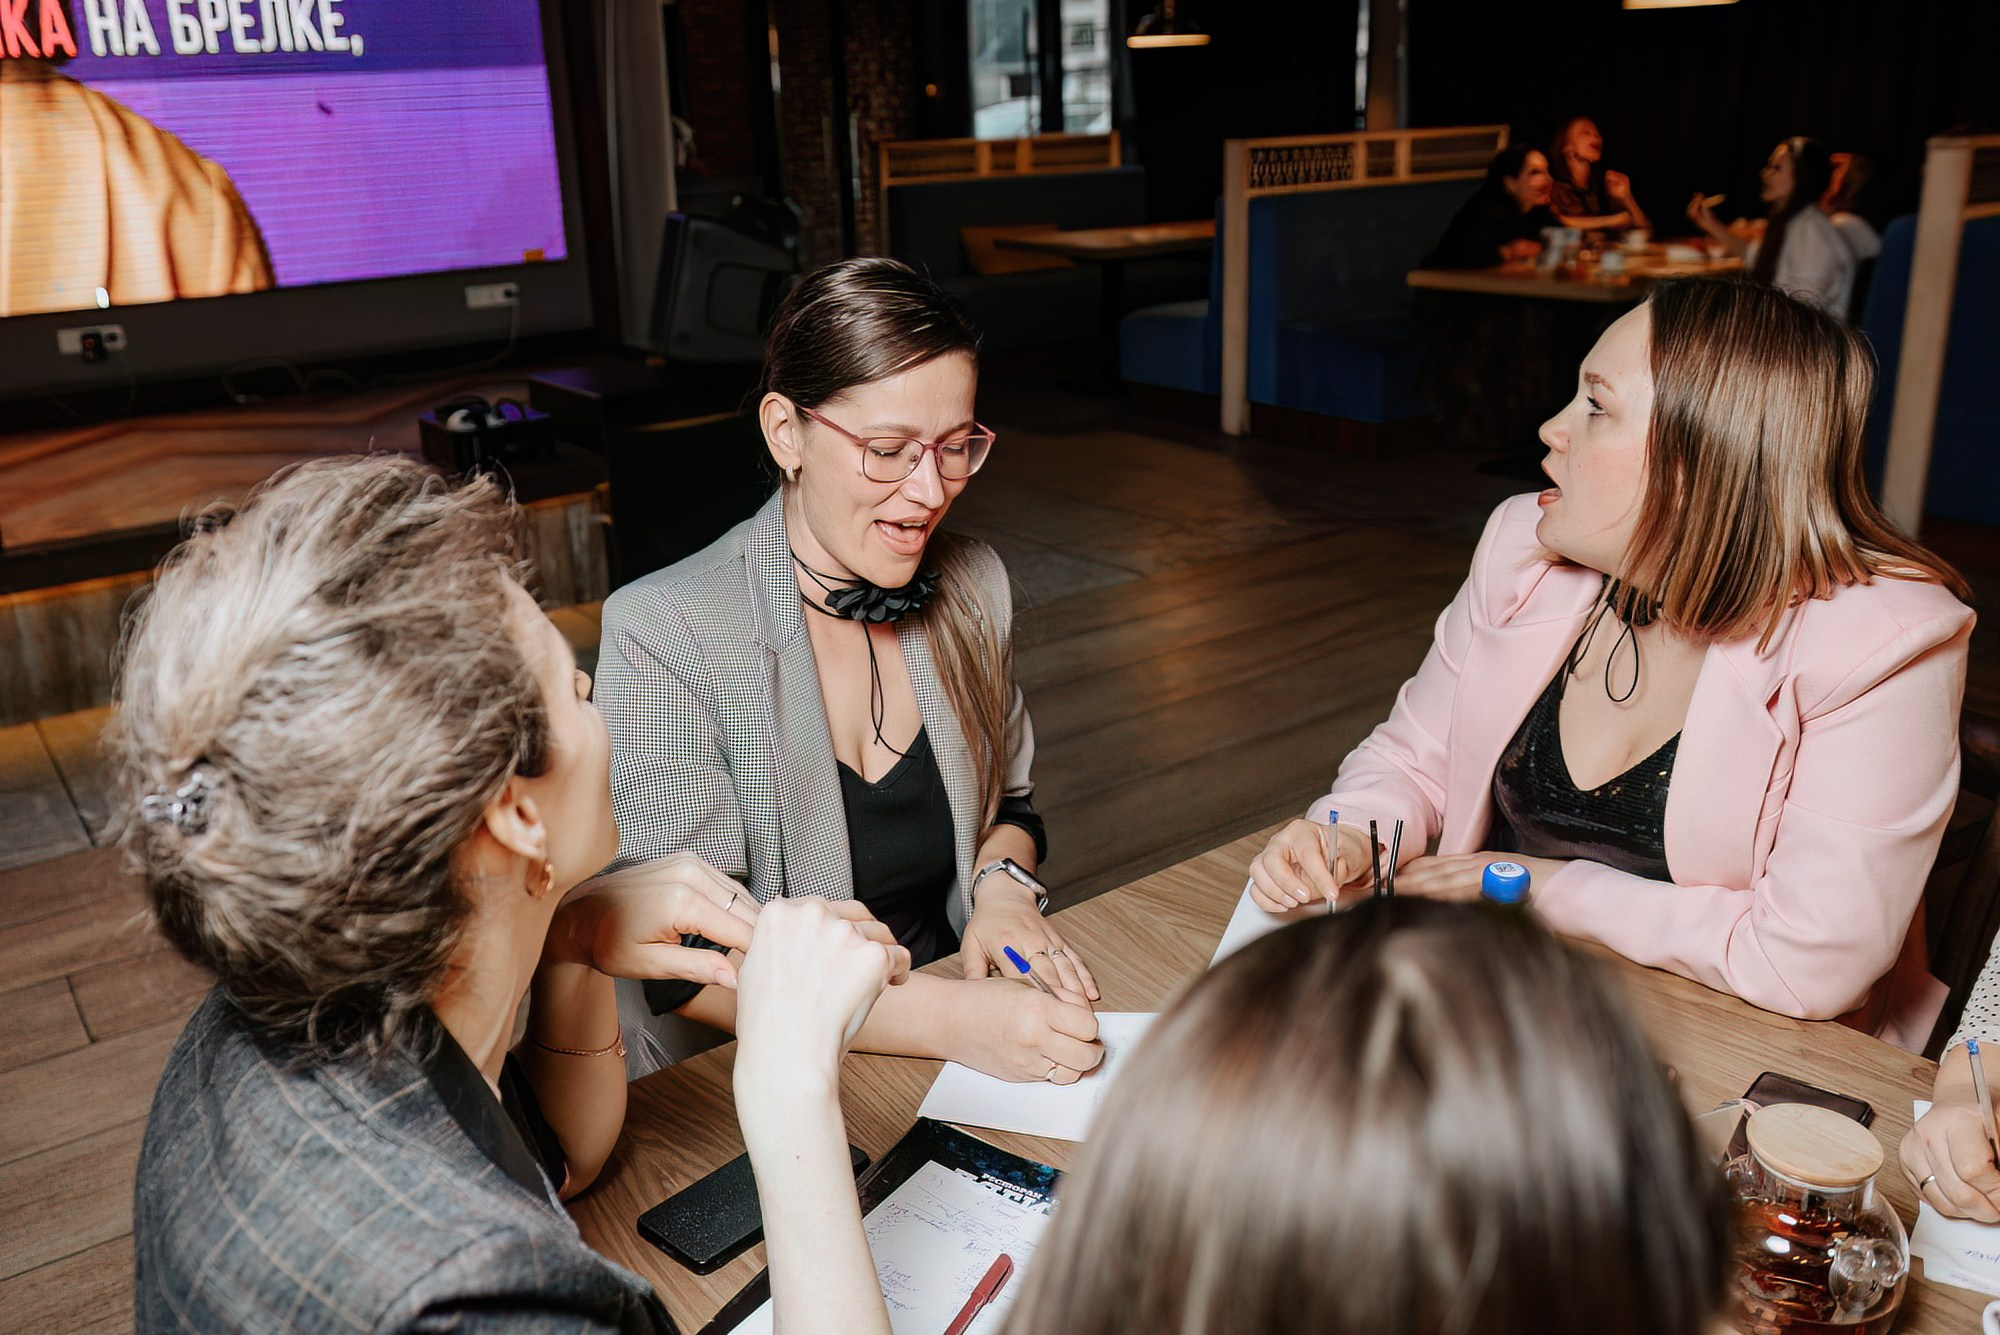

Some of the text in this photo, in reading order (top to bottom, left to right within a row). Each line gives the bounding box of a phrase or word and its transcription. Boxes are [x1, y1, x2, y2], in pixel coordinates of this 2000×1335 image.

[0, 0, 364, 58] КА НА БРЕЛКЕ,
